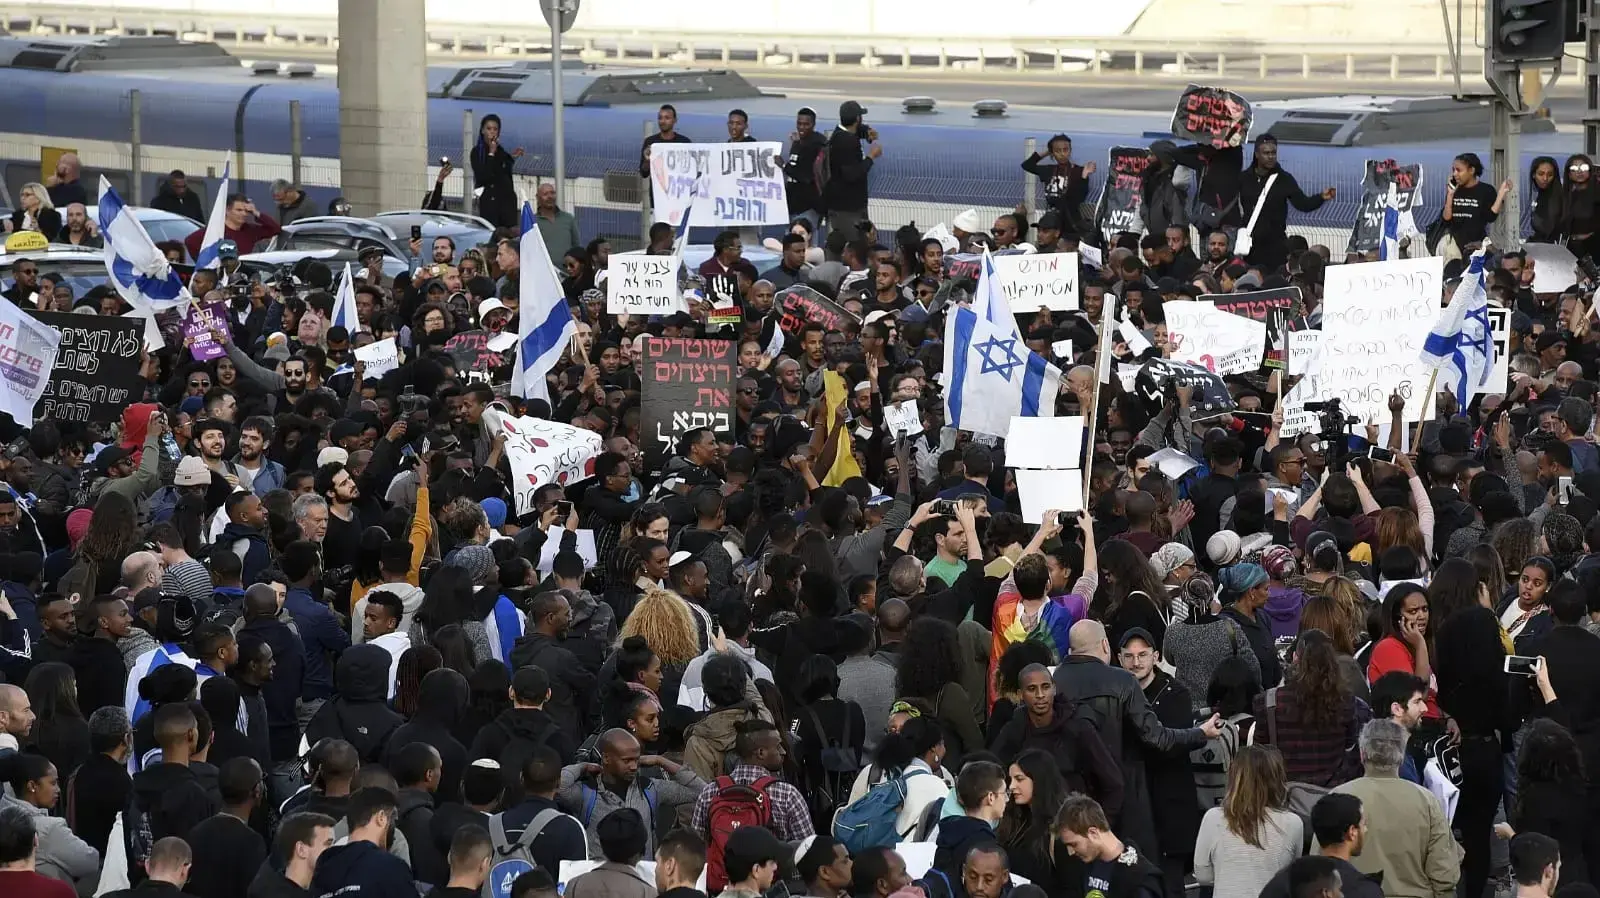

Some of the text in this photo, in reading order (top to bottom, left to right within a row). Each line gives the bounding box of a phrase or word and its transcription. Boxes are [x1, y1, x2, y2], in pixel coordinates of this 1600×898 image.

[721, 147, 775, 178] אנחנו
[1116, 156, 1150, 172] וטרים
[1115, 174, 1143, 190] צחים
[714, 197, 767, 223] והוגנת
[1109, 210, 1134, 226] יתא
[620, 260, 671, 275] צבע עור
[624, 275, 663, 288] הוא לא
[615, 291, 670, 307] חשד סביר!
[61, 328, 110, 352] רוצים
[111, 329, 139, 358] לא
[445, 334, 487, 350] צחים
[648, 338, 730, 359] שוטרים
[655, 362, 730, 384] רוצחים
[60, 380, 107, 403] רוצחים
[108, 388, 129, 403] יש
[695, 388, 730, 407] את
[44, 399, 91, 422] החוק
[1288, 407, 1303, 416] הודה
